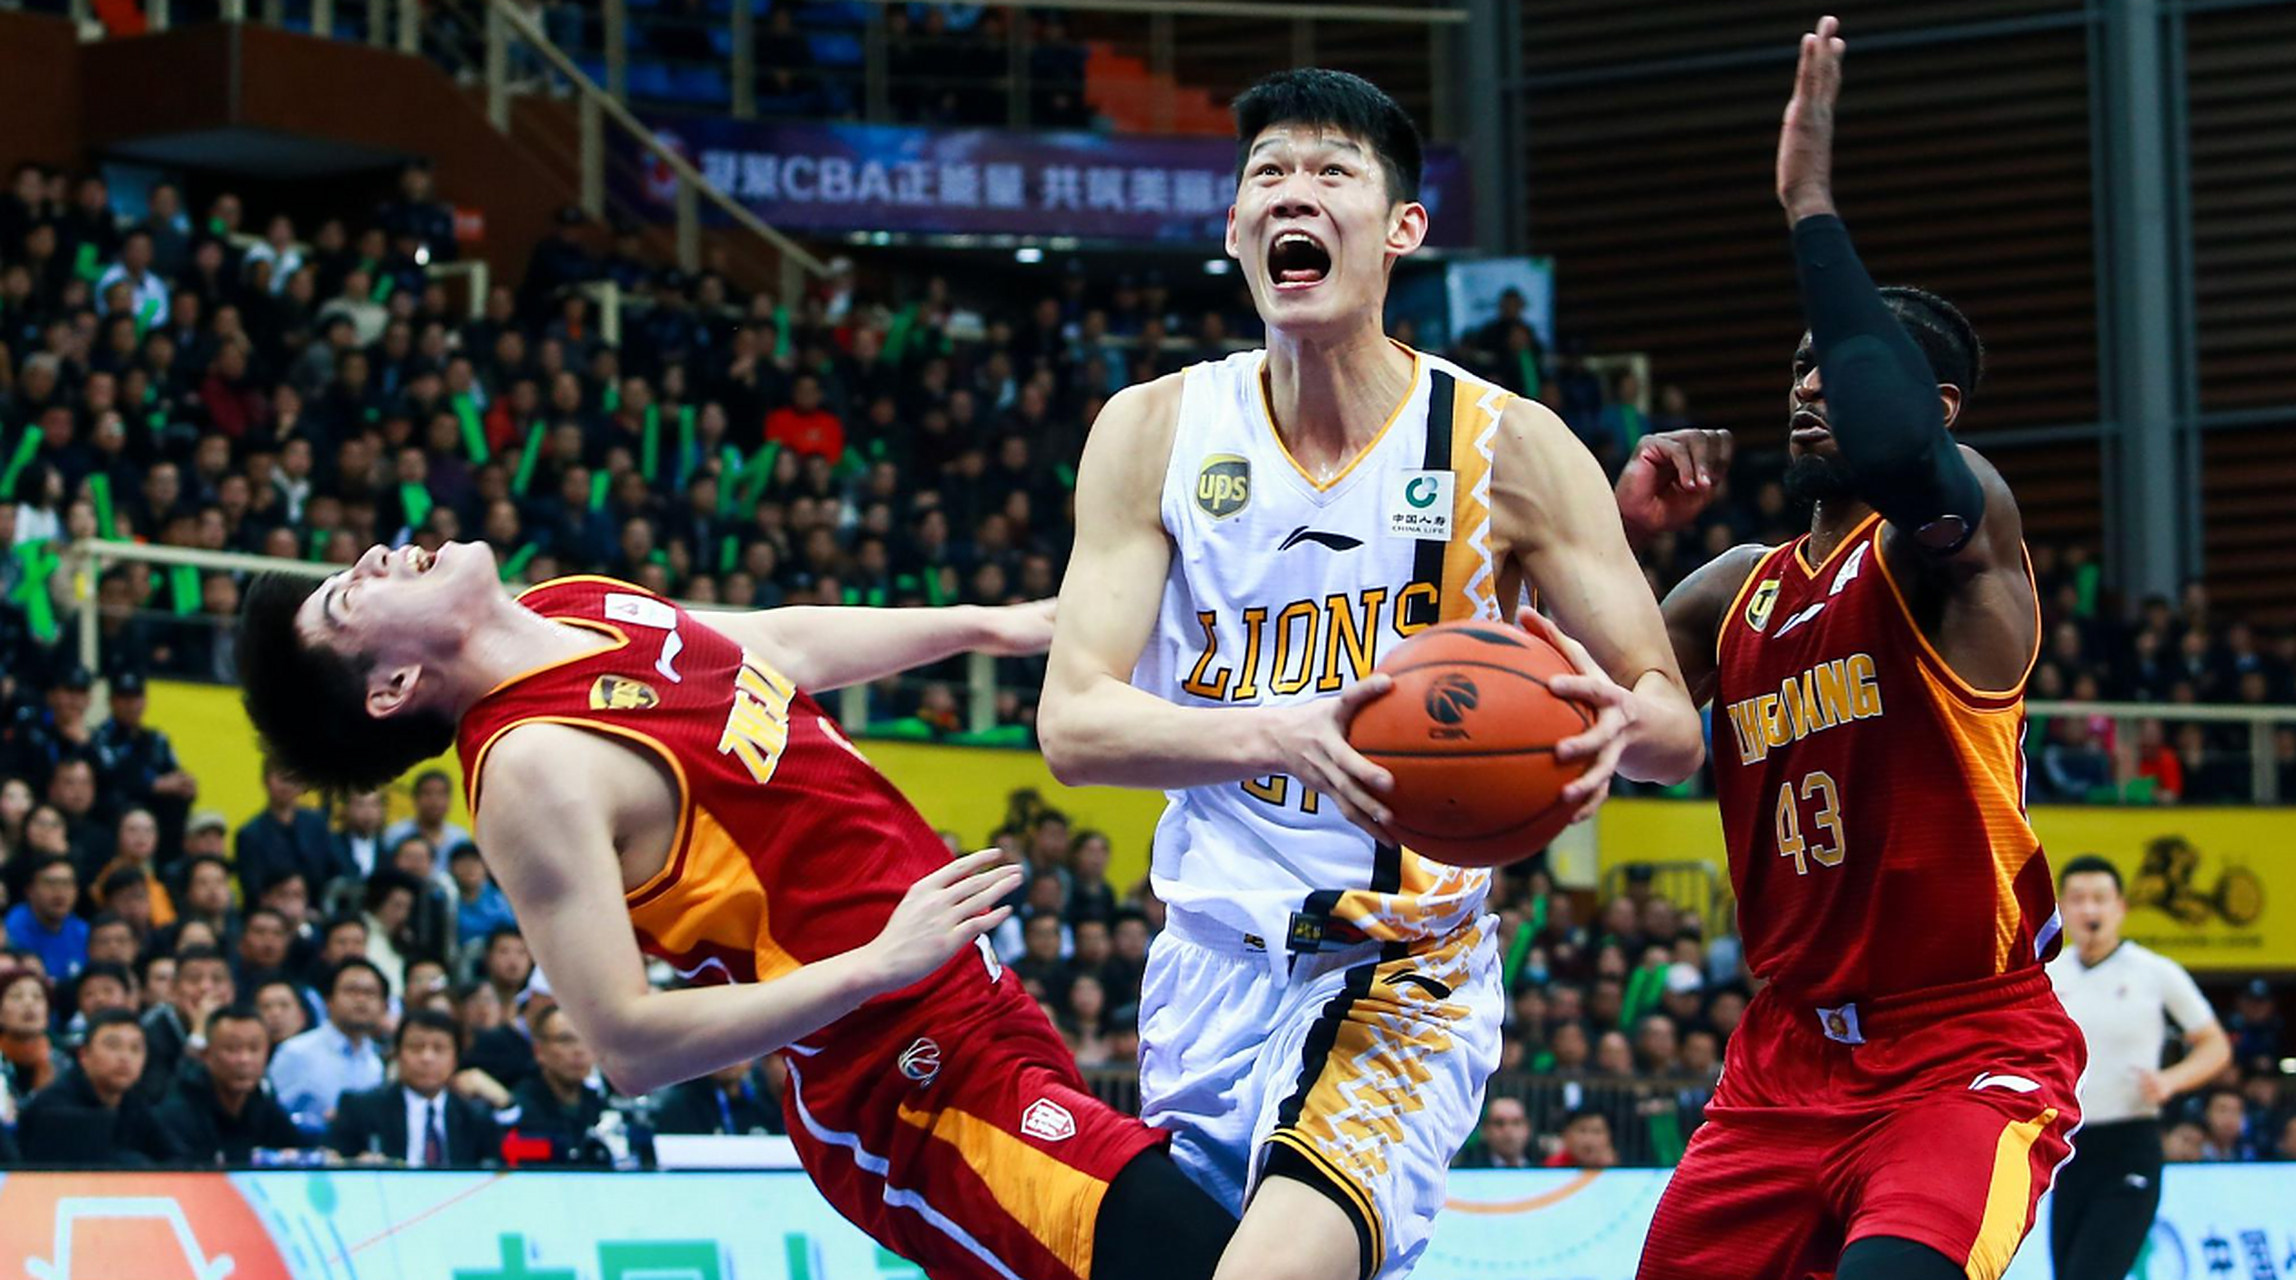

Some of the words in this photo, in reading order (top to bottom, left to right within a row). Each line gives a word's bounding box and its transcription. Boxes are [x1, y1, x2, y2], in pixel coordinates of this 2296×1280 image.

[1199, 474, 1247, 510] ups
[1392, 513, 1446, 526] 中国人寿
[1392, 525, 1421, 533] CHINA
[1424, 527, 1445, 535] LIFE
[1182, 581, 1439, 702] LIONS
[1775, 770, 1846, 875] 43
[2200, 1226, 2296, 1280] 中国
